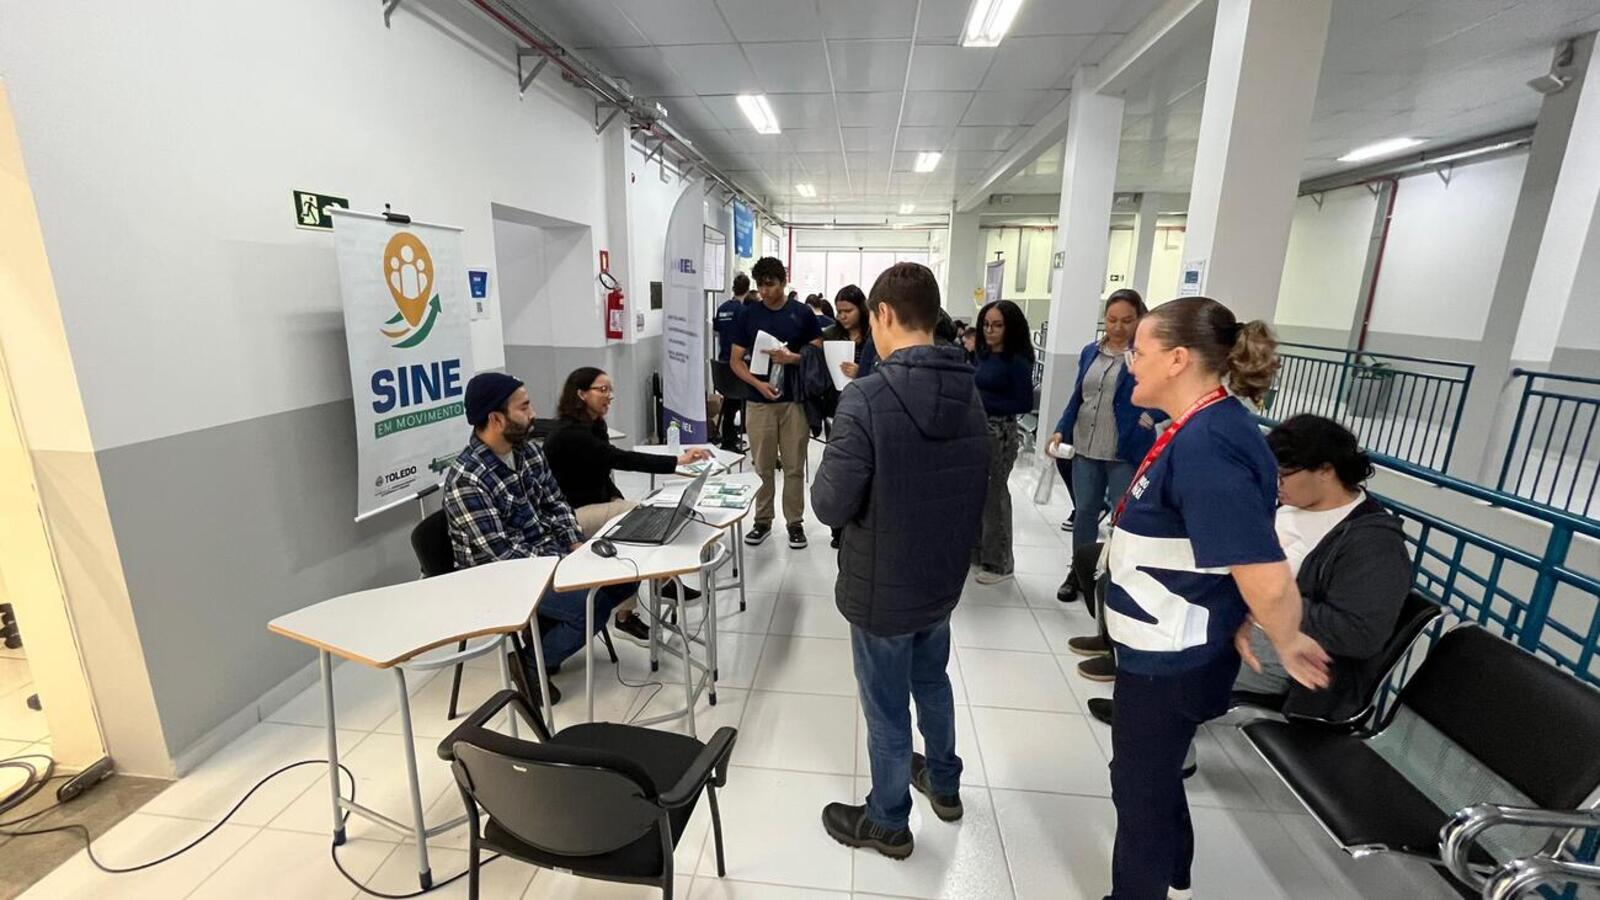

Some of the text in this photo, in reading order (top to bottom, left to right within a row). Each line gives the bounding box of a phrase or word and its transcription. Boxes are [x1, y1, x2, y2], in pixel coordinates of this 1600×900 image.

[680, 258, 696, 274] IEL
[371, 359, 463, 414] SINE
[377, 404, 462, 436] EM MOVIMENTO
[385, 465, 417, 483] TOLEDO
